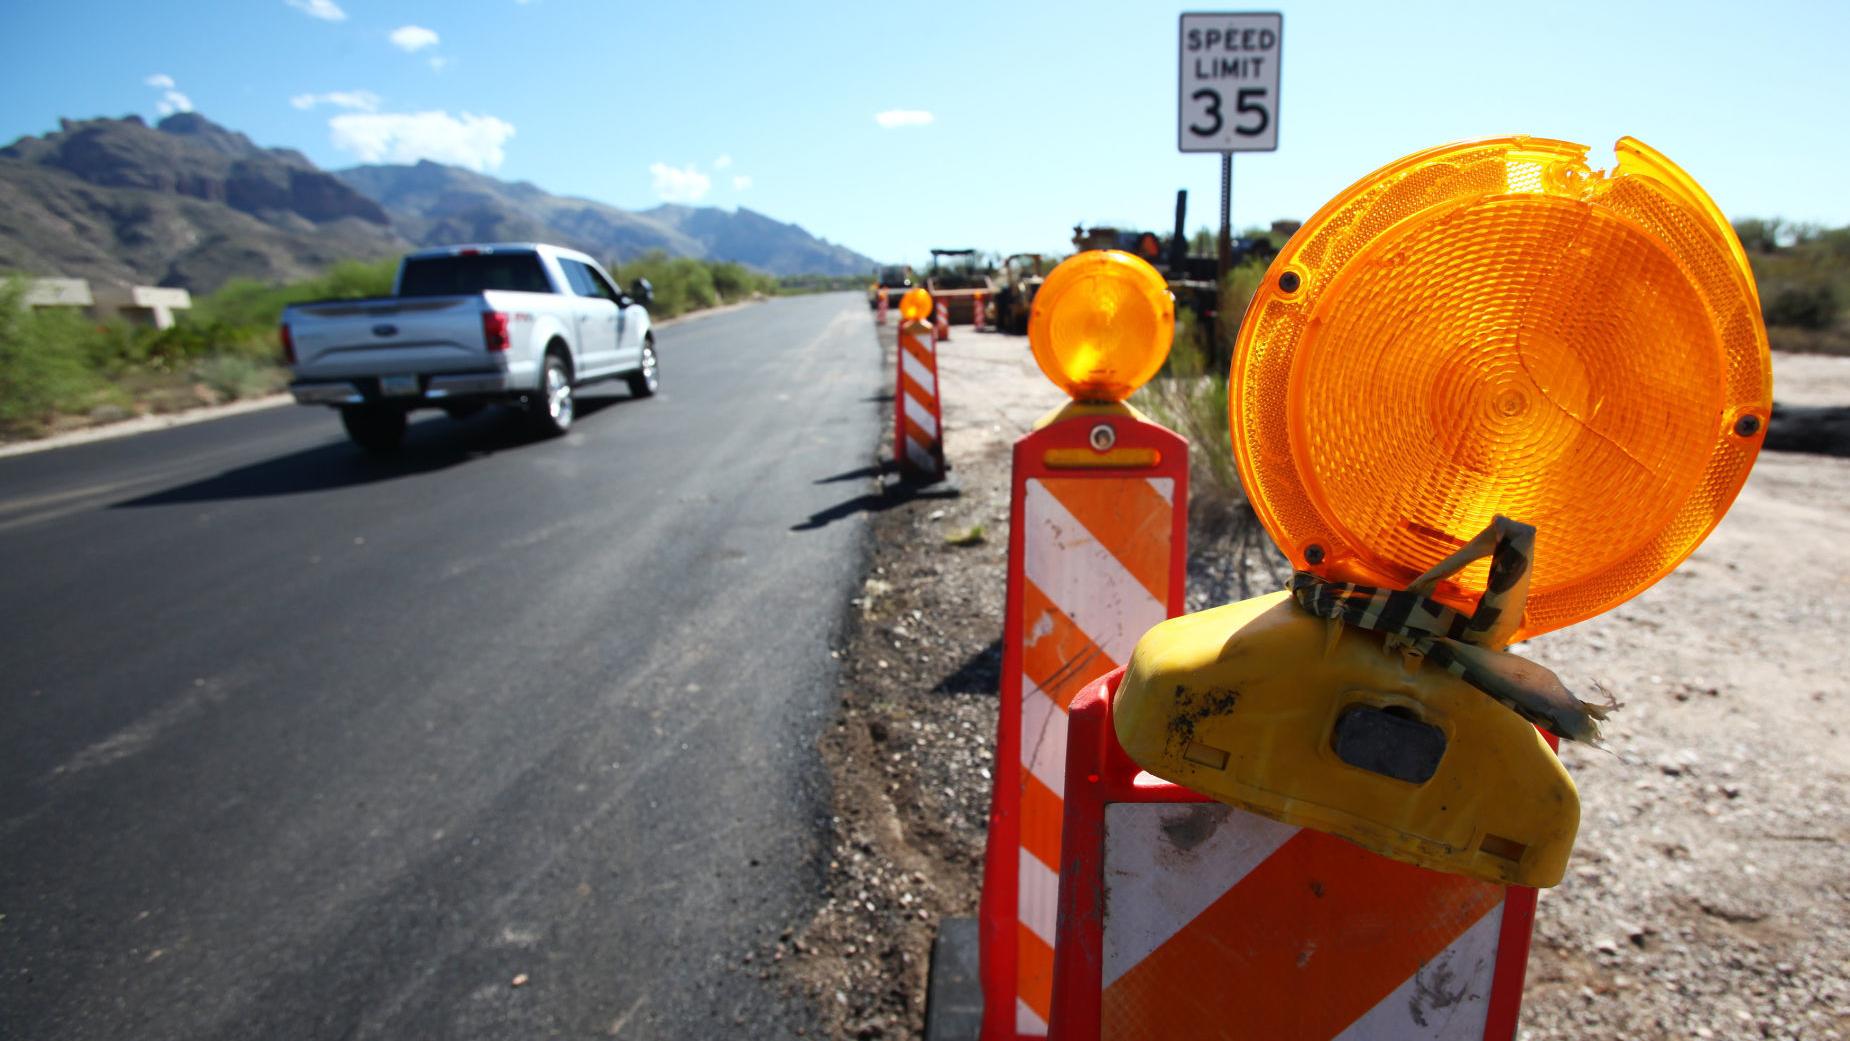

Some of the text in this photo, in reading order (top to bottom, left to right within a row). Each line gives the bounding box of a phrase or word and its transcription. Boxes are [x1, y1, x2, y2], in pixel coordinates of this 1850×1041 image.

[1188, 28, 1276, 51] SPEED
[1195, 57, 1264, 79] LIMIT
[1189, 87, 1269, 138] 35
